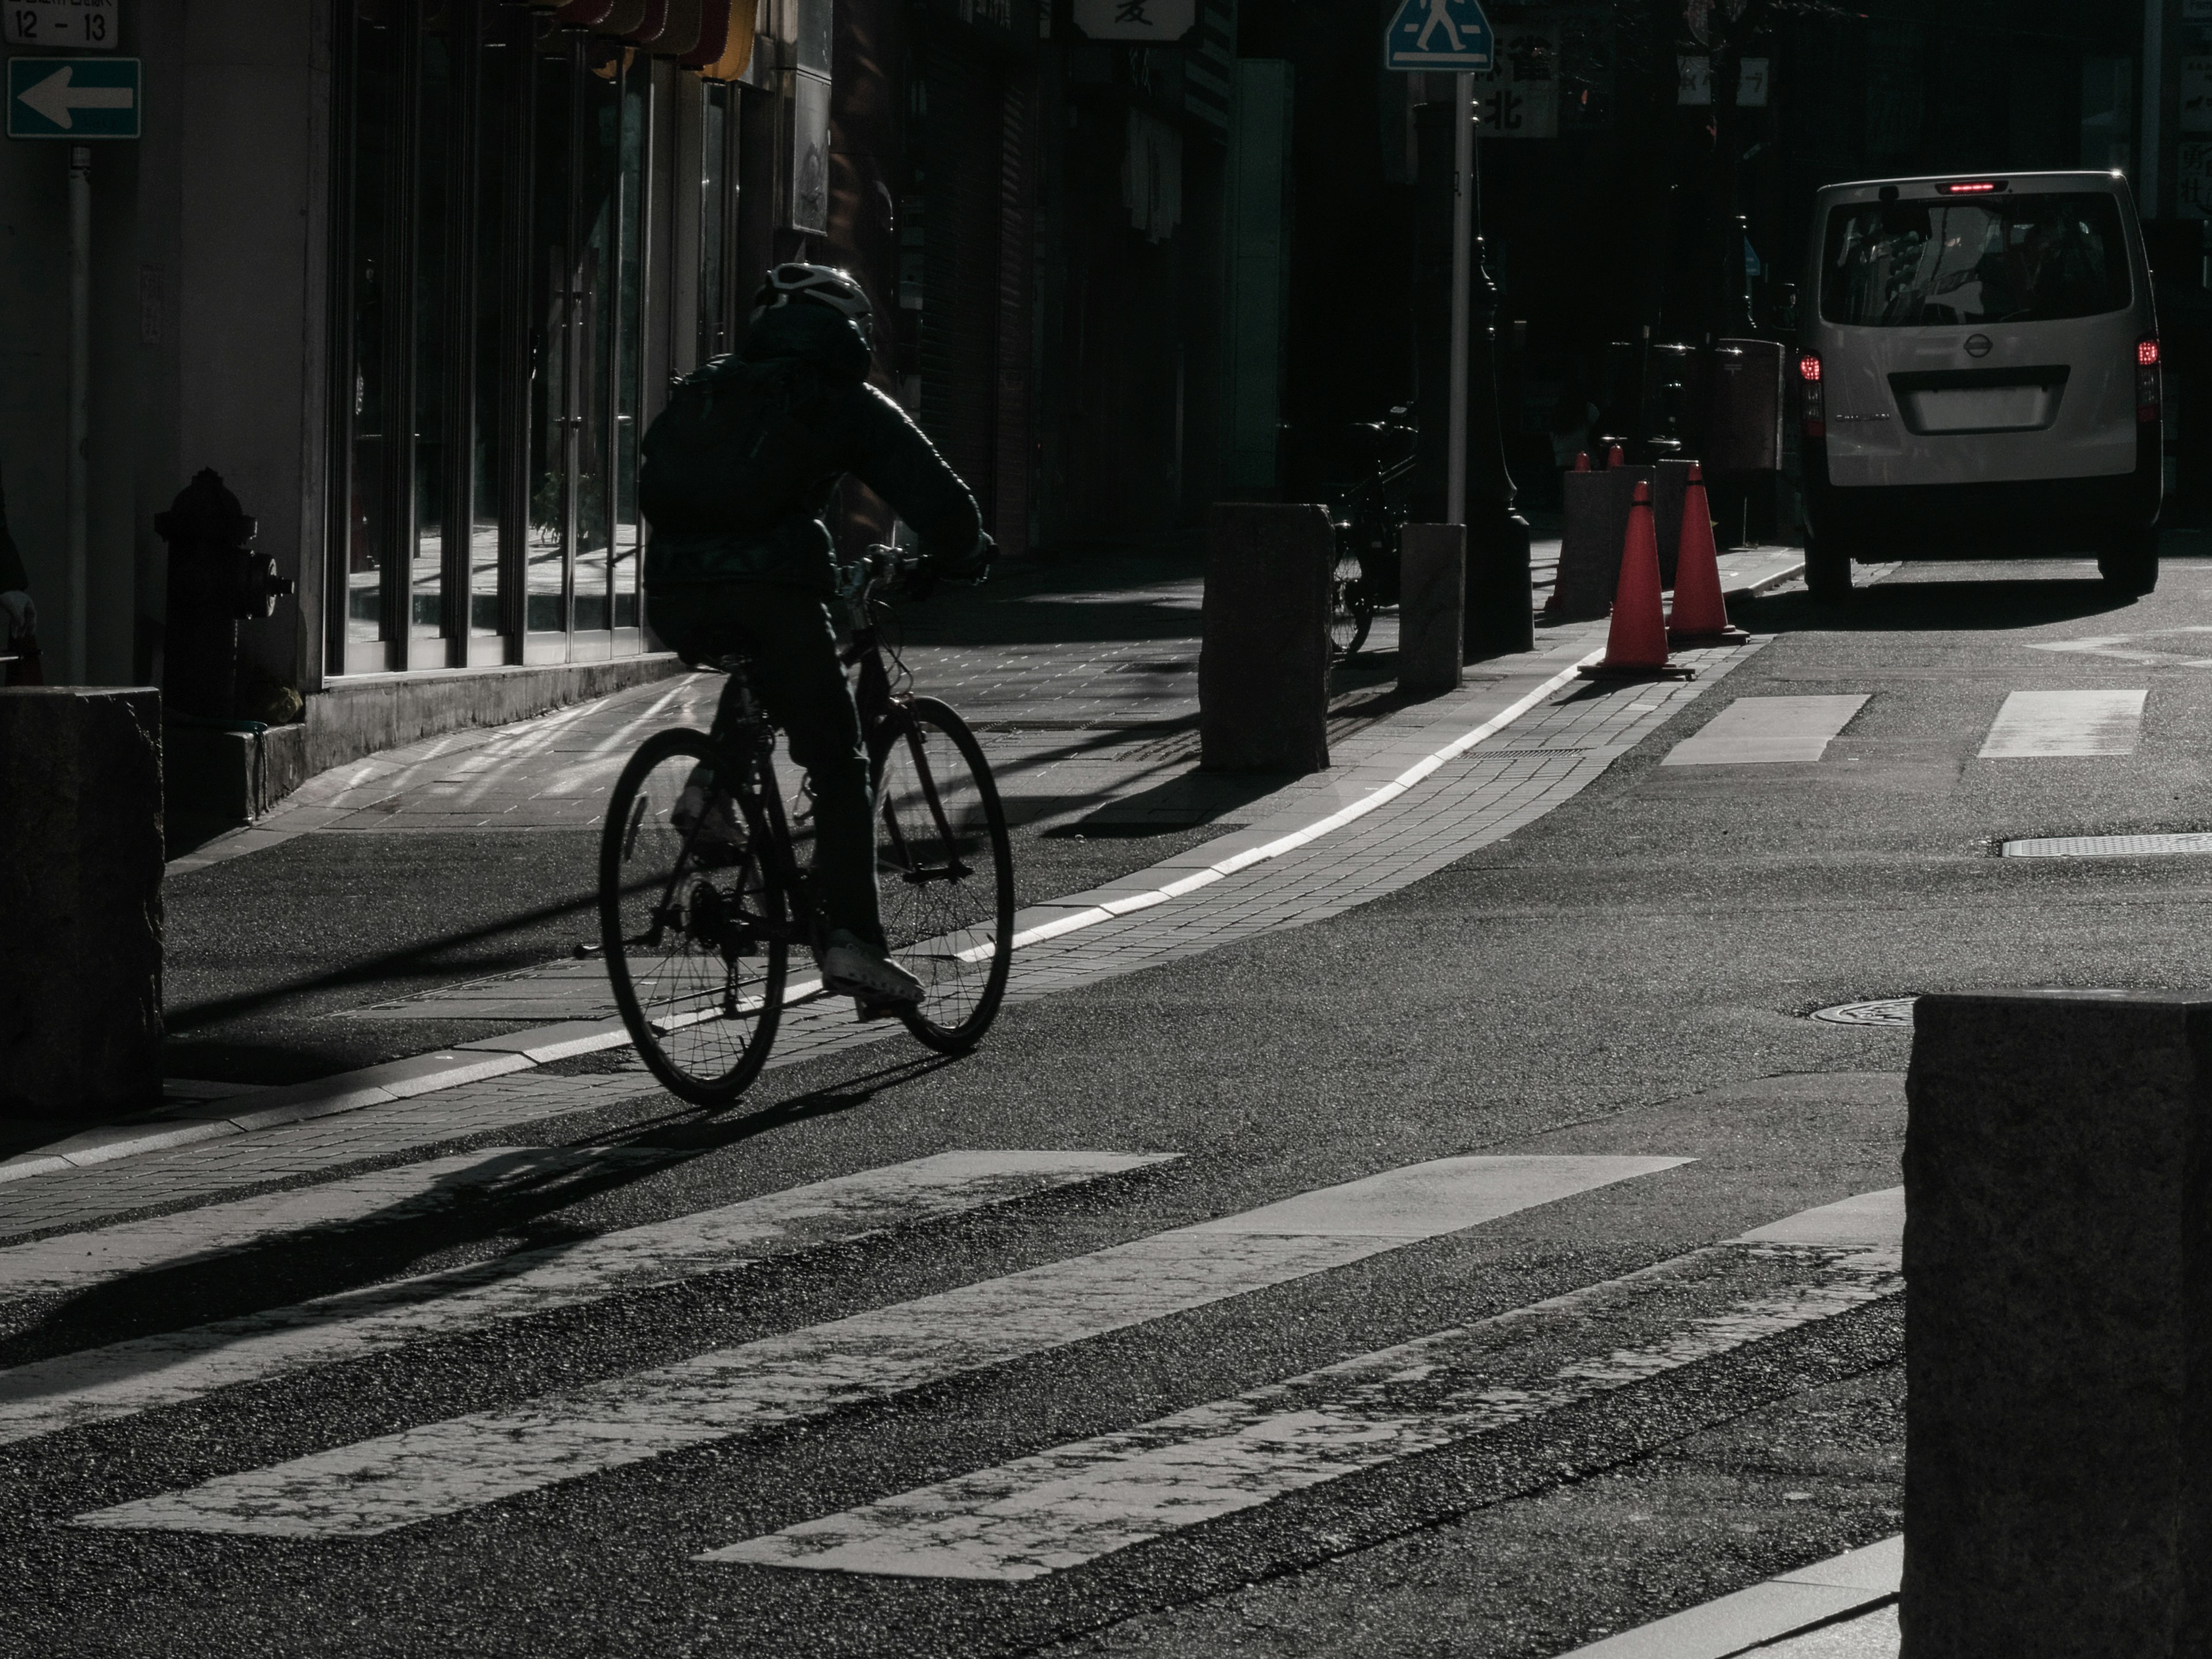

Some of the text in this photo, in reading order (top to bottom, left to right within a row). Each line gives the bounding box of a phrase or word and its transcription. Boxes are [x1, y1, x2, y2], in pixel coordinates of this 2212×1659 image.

[16, 10, 37, 38] 12
[85, 14, 105, 41] 13
[1484, 90, 1523, 130] 北
